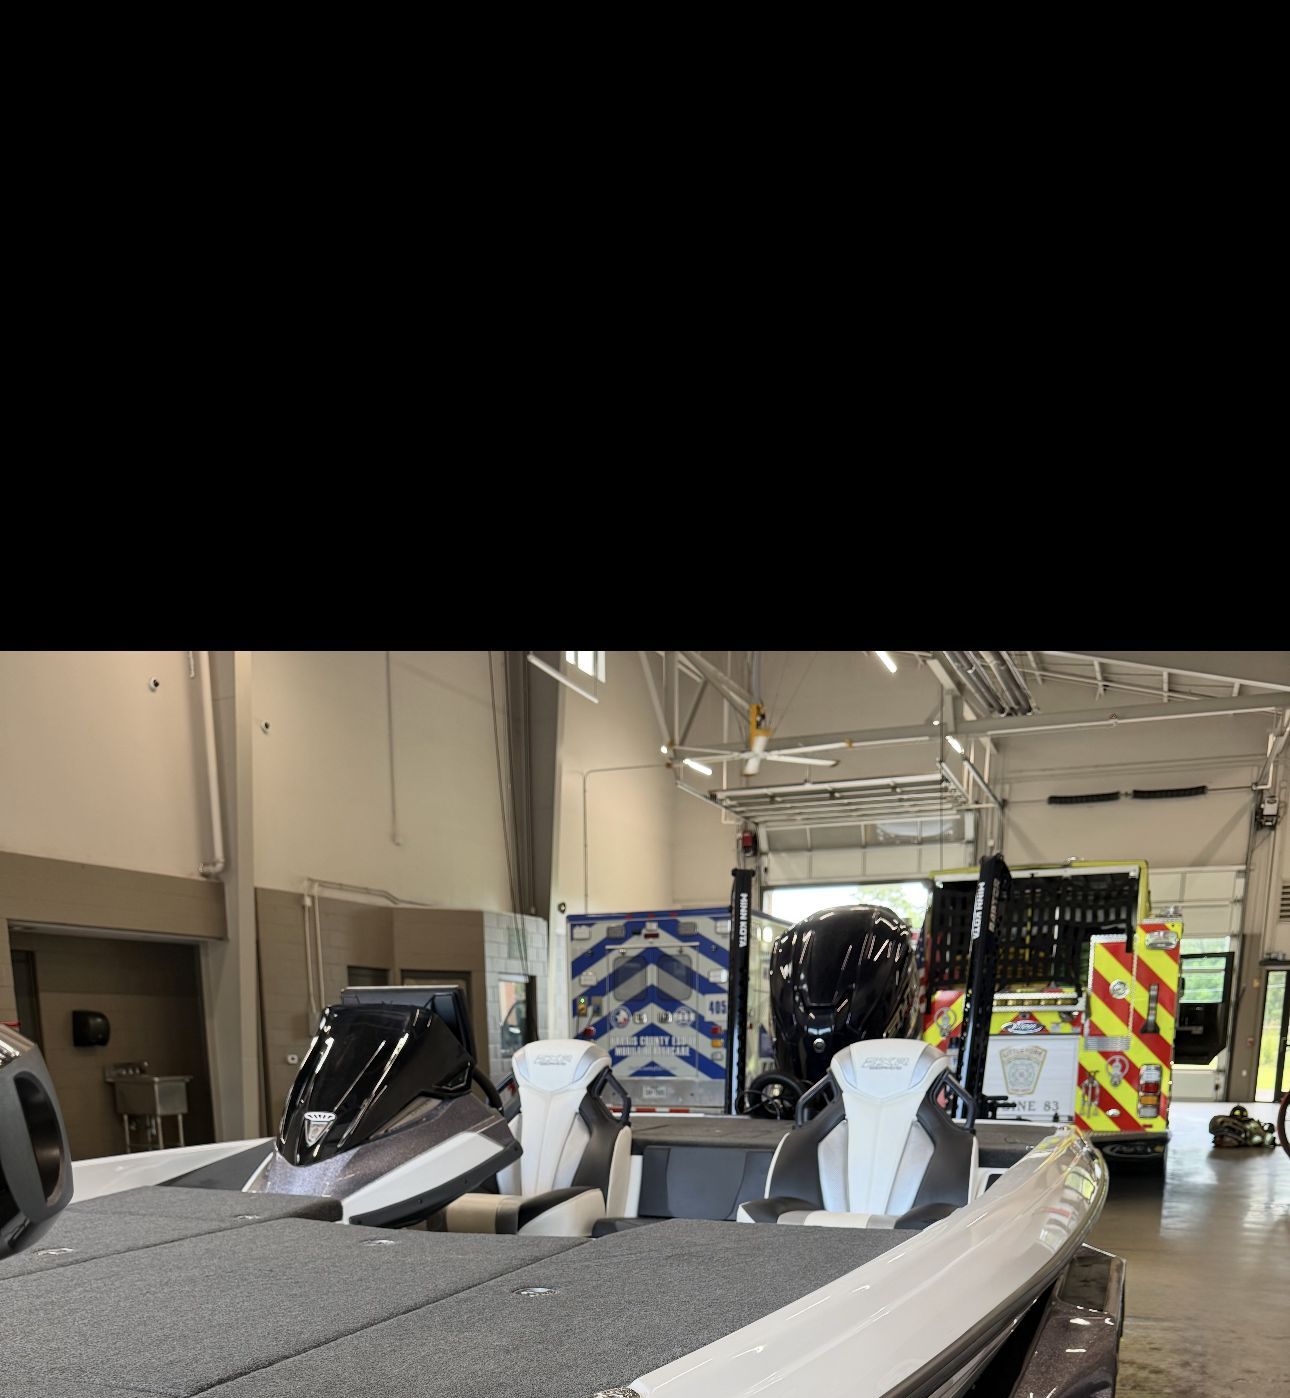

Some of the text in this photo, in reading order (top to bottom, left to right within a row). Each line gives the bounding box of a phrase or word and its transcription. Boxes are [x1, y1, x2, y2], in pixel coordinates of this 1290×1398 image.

[739, 892, 748, 948] MINN KOTA
[971, 881, 986, 940] MINN KOTA
[640, 1035, 671, 1047] COUNTY
[1043, 1100, 1060, 1112] 83
